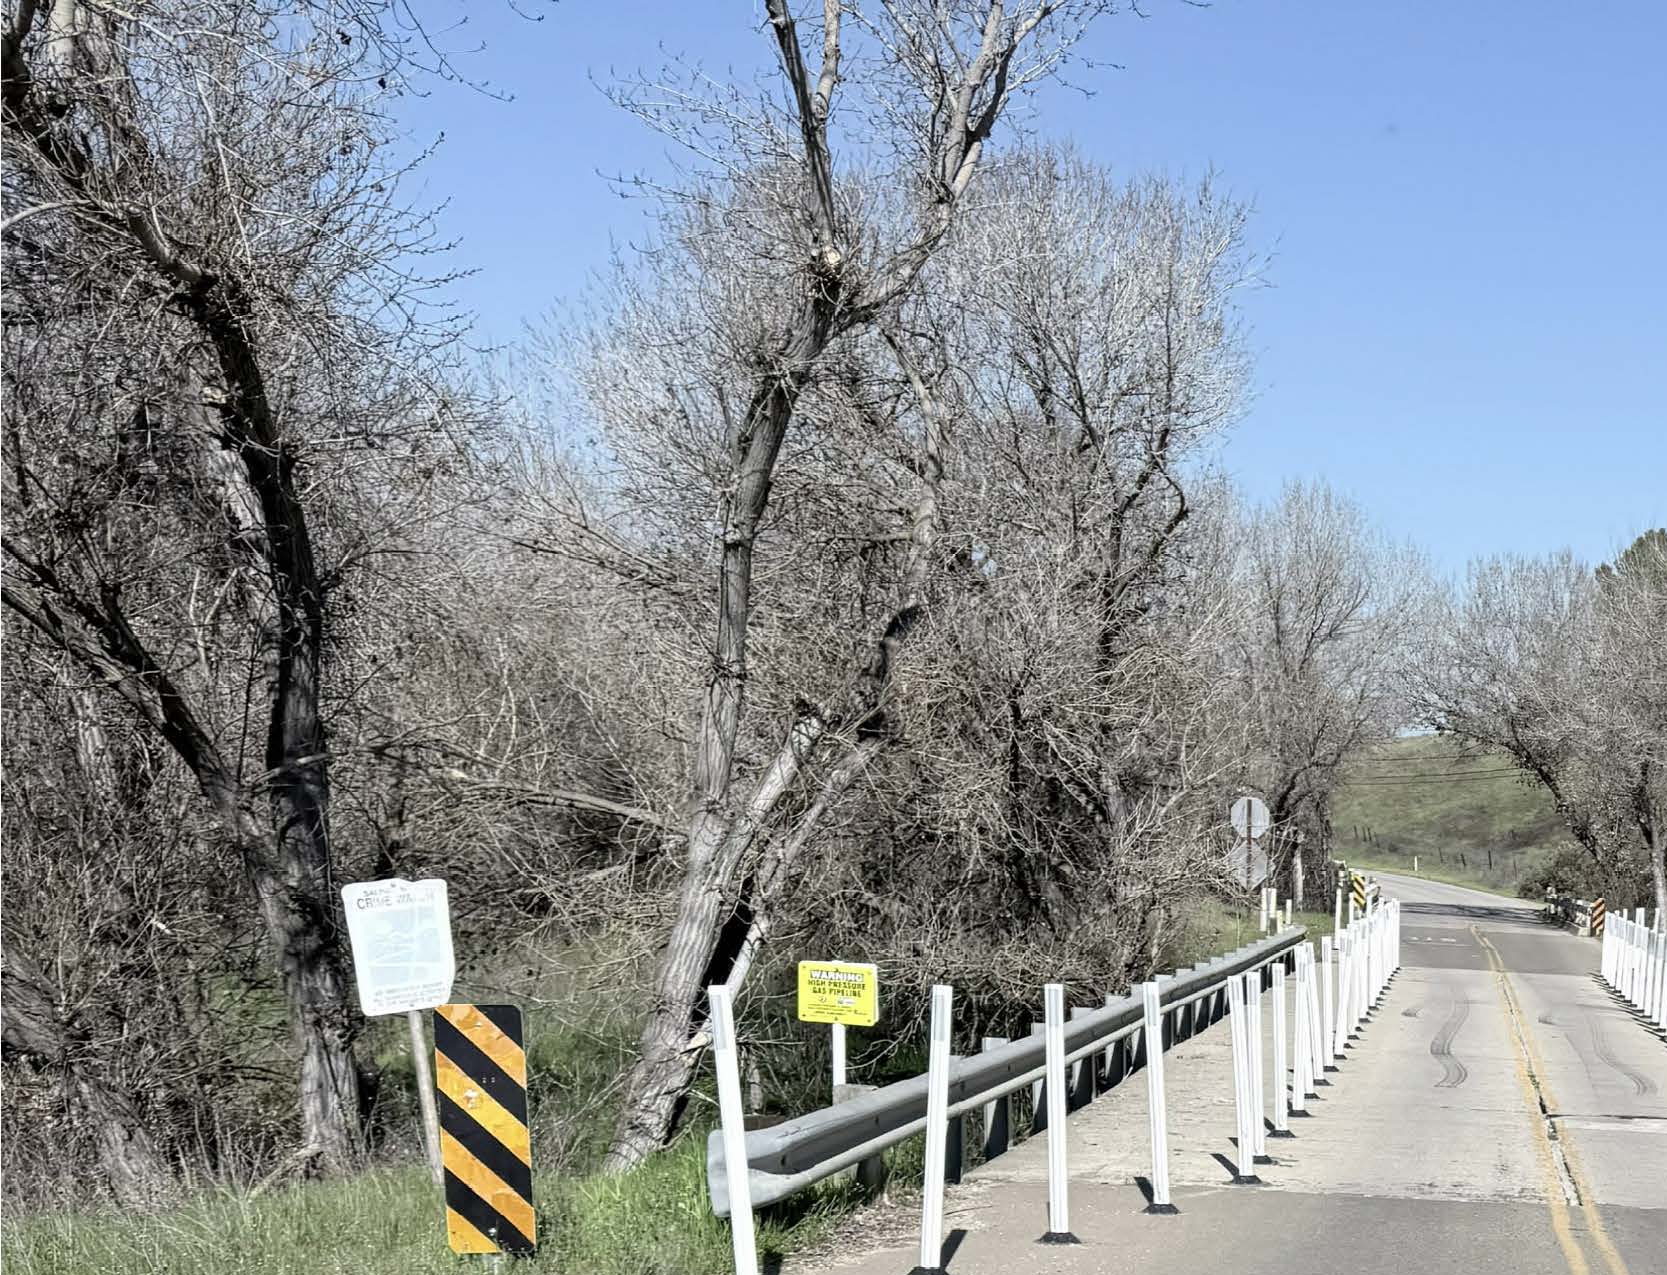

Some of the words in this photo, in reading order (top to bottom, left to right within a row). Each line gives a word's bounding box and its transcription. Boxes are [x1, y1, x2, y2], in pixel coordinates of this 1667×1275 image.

[810, 969, 864, 982] WARNING
[828, 981, 866, 990] PRESSURE
[812, 987, 827, 995] GAS
[829, 988, 862, 998] PIPELINE
